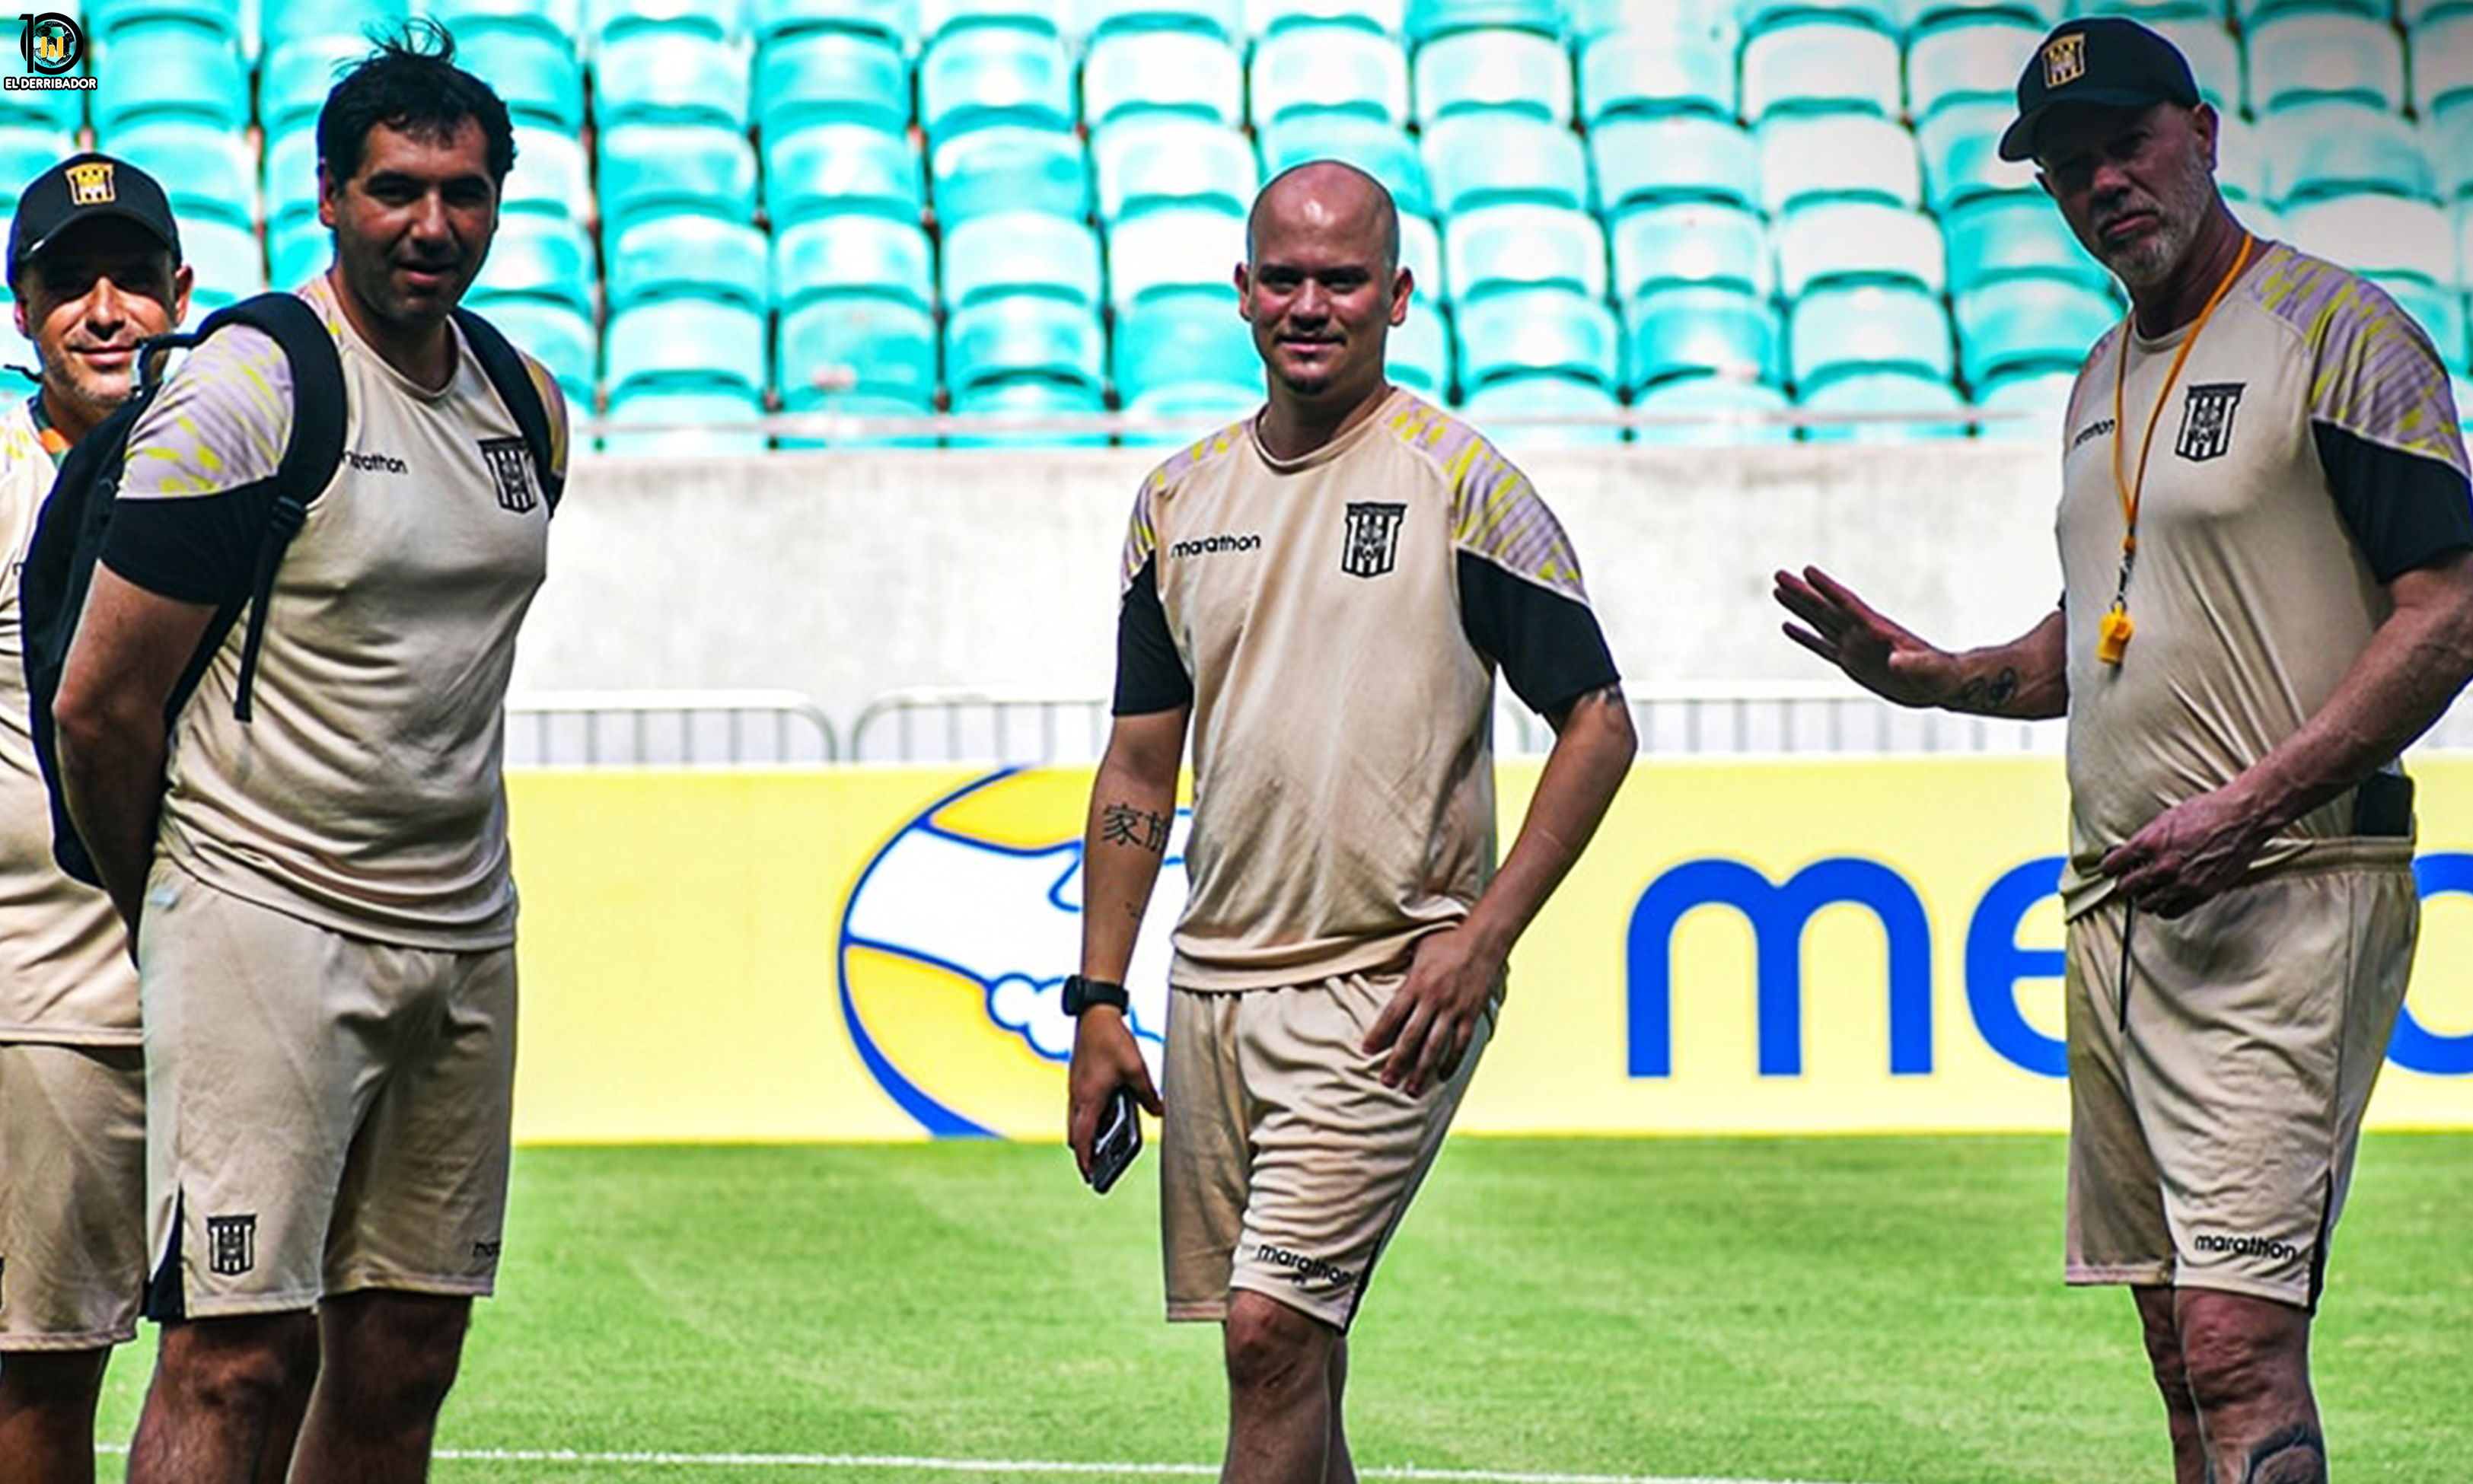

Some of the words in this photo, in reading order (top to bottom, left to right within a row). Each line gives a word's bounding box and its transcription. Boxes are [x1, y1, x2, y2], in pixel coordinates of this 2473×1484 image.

[1171, 534, 1261, 557] marathon
[2194, 1234, 2297, 1262] marathon
[1257, 1244, 1353, 1284] marathon
